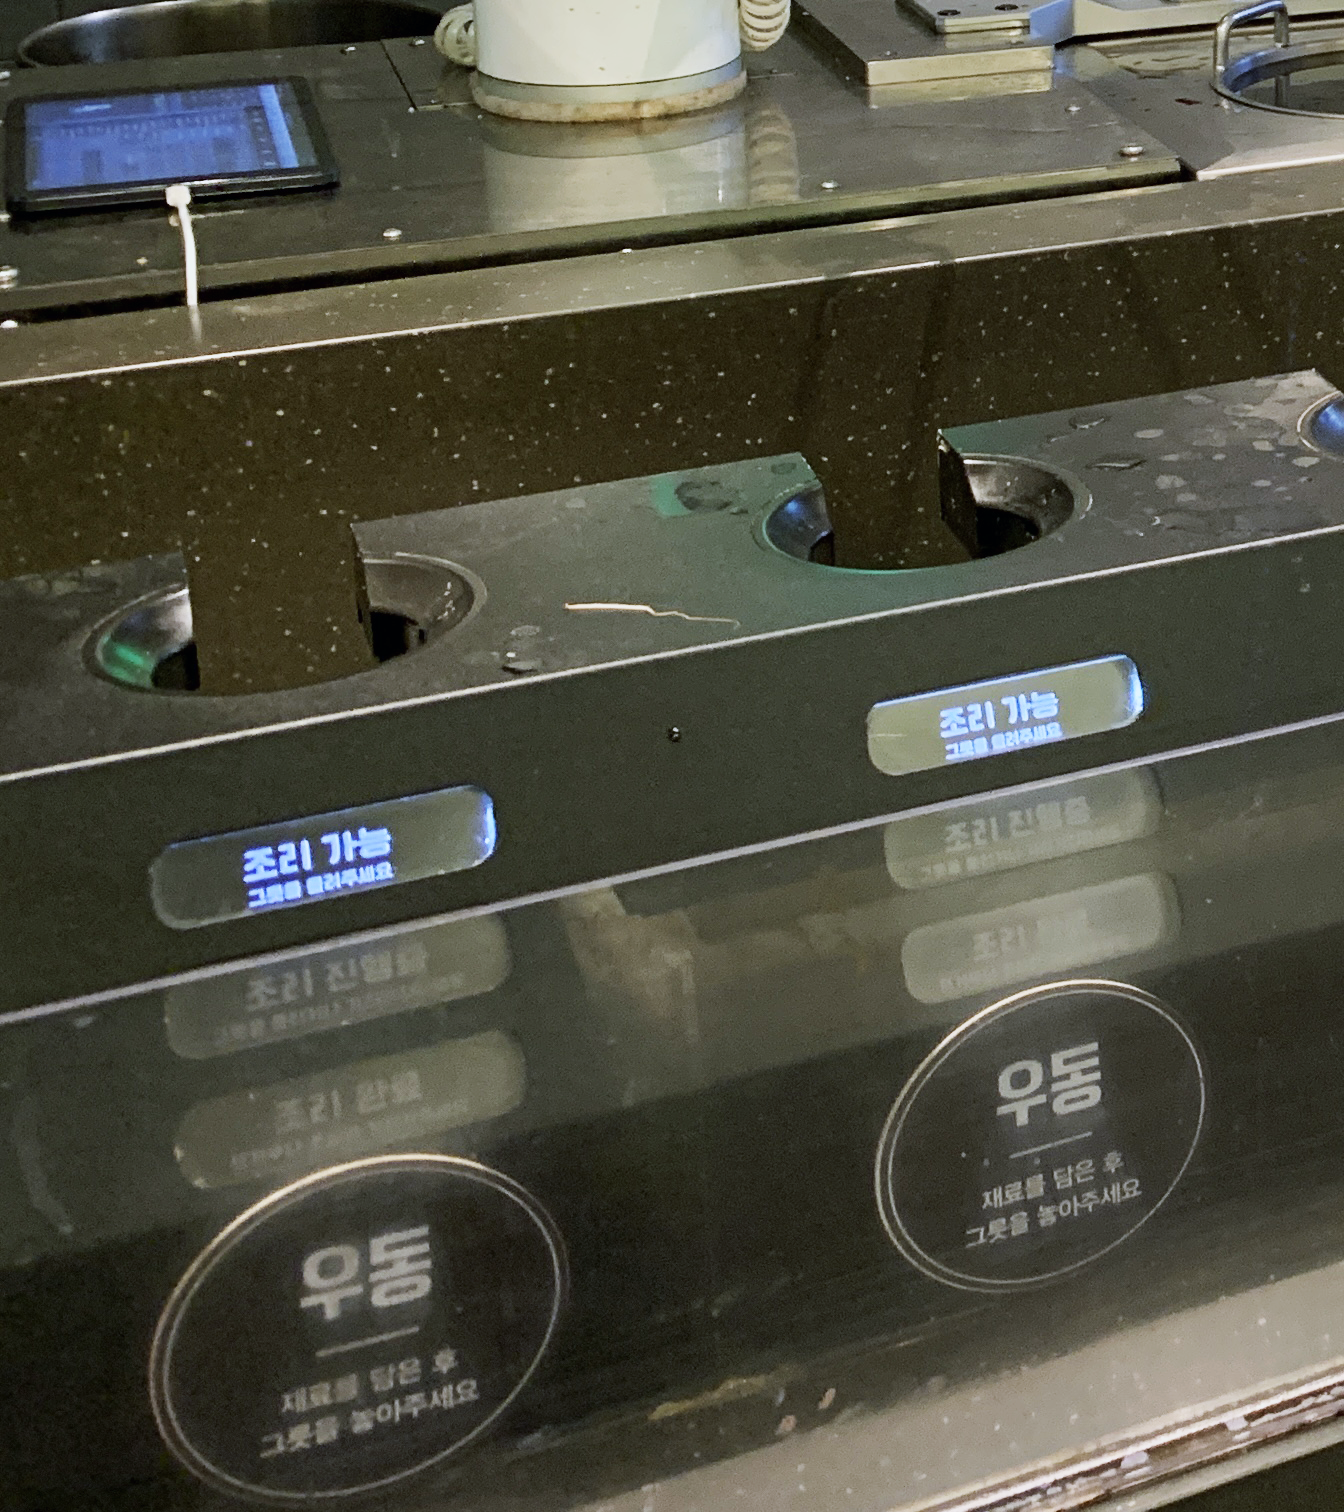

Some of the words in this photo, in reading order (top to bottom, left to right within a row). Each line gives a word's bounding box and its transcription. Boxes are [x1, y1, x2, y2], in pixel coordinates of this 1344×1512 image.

[940, 700, 996, 739] 조리
[1000, 691, 1060, 725] 가능
[243, 838, 314, 884] 조리
[320, 826, 393, 866] 가능
[944, 818, 1000, 854] 조리
[246, 968, 314, 1013] 조리
[996, 1041, 1103, 1128] 우동
[981, 1173, 1046, 1210] 재료를
[1053, 1158, 1096, 1190] 담은
[1102, 1150, 1125, 1174] 후
[965, 1210, 1030, 1249] 그릇을
[1036, 1177, 1143, 1229] 놓아주세요
[300, 1224, 433, 1321] 우동
[280, 1372, 361, 1416] 재료를
[368, 1357, 423, 1393] 담은
[431, 1346, 458, 1374] 후
[259, 1414, 340, 1459] 그릇을
[349, 1377, 481, 1435] 놓아주세요
